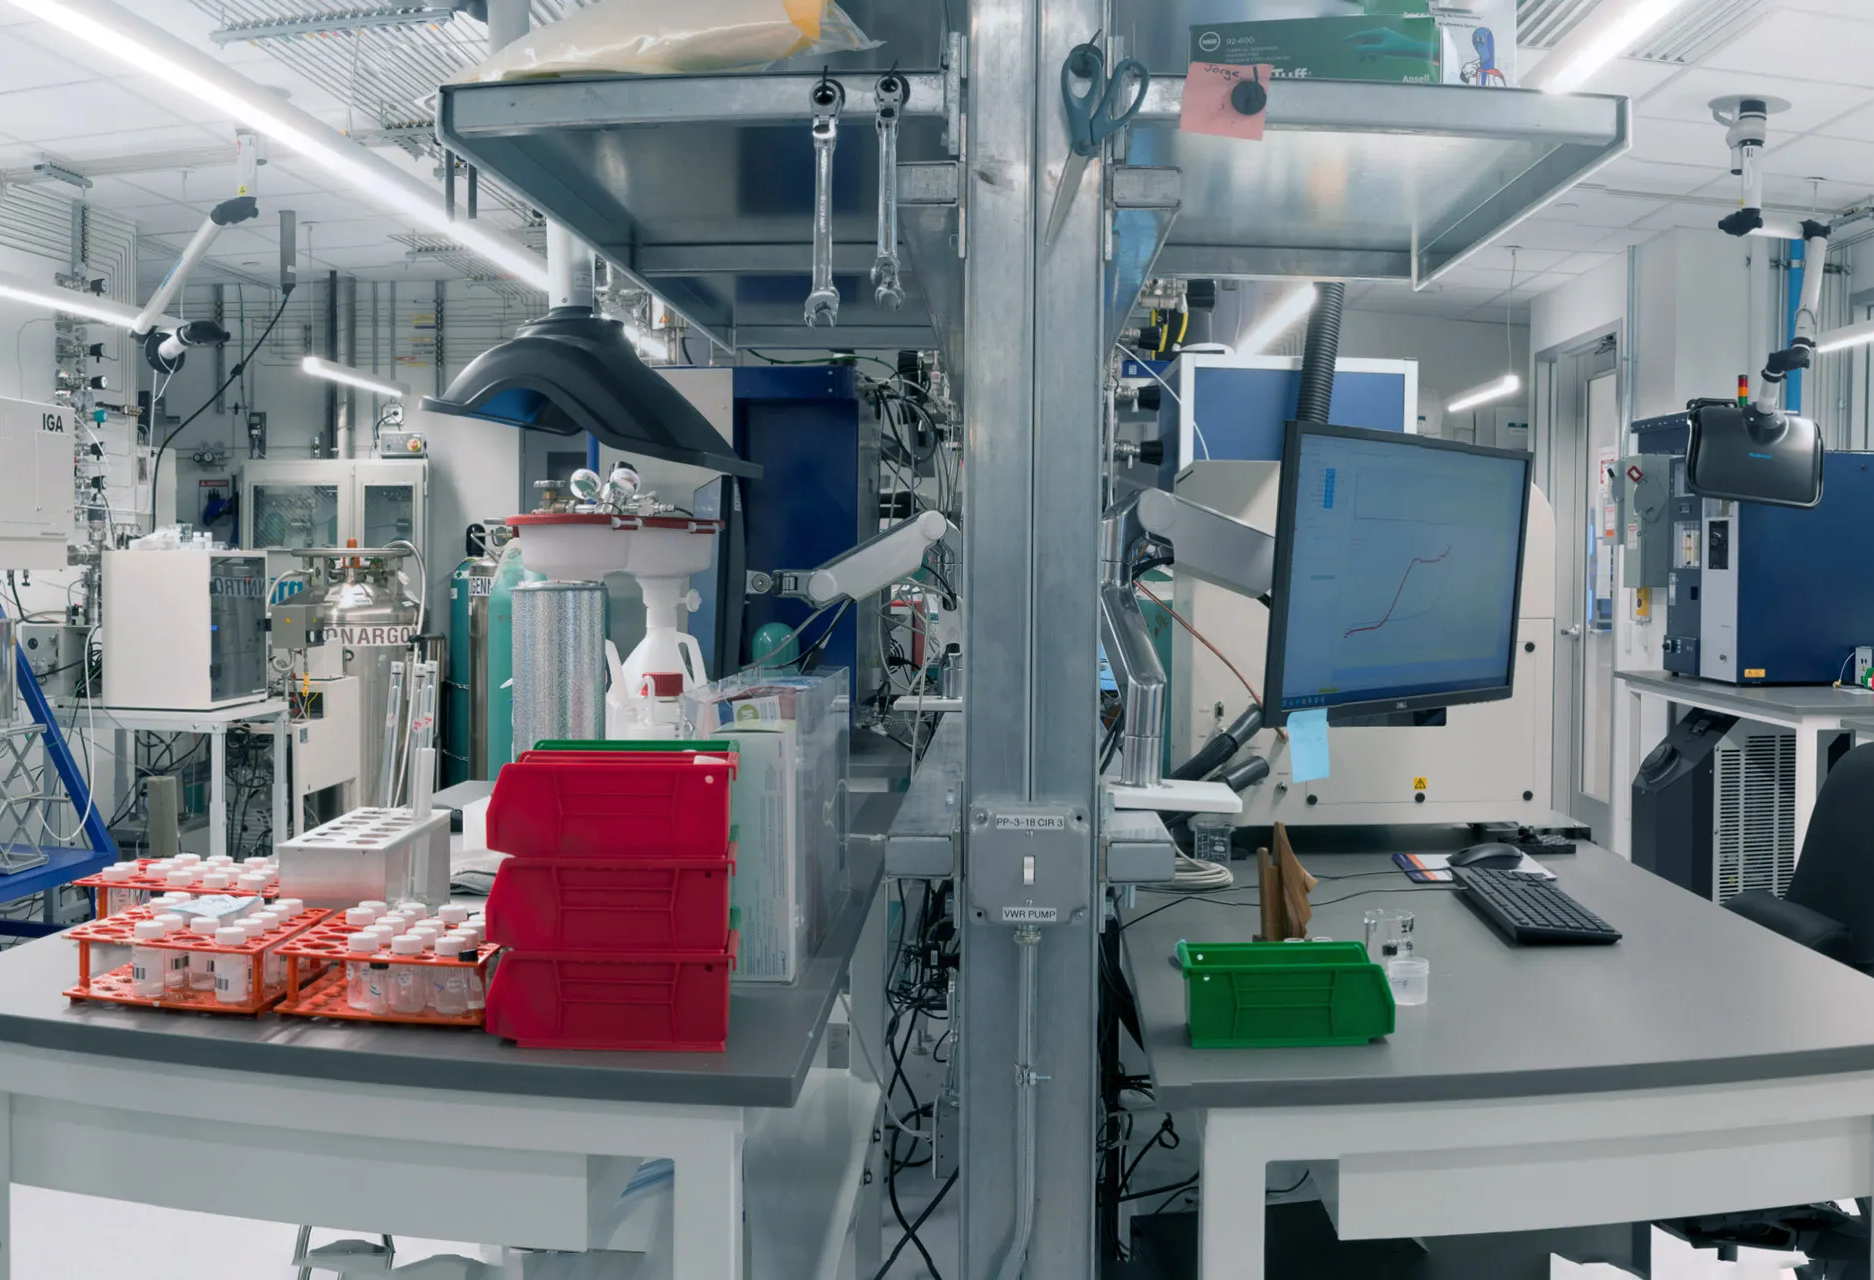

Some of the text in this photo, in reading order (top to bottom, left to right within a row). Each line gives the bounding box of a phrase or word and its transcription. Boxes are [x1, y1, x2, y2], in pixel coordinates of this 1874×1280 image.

[1403, 75, 1430, 83] Ansell
[42, 403, 63, 432] IGA
[997, 818, 1063, 827] PP-3-18 CIR 3
[1004, 910, 1056, 919] VWR PUMP
